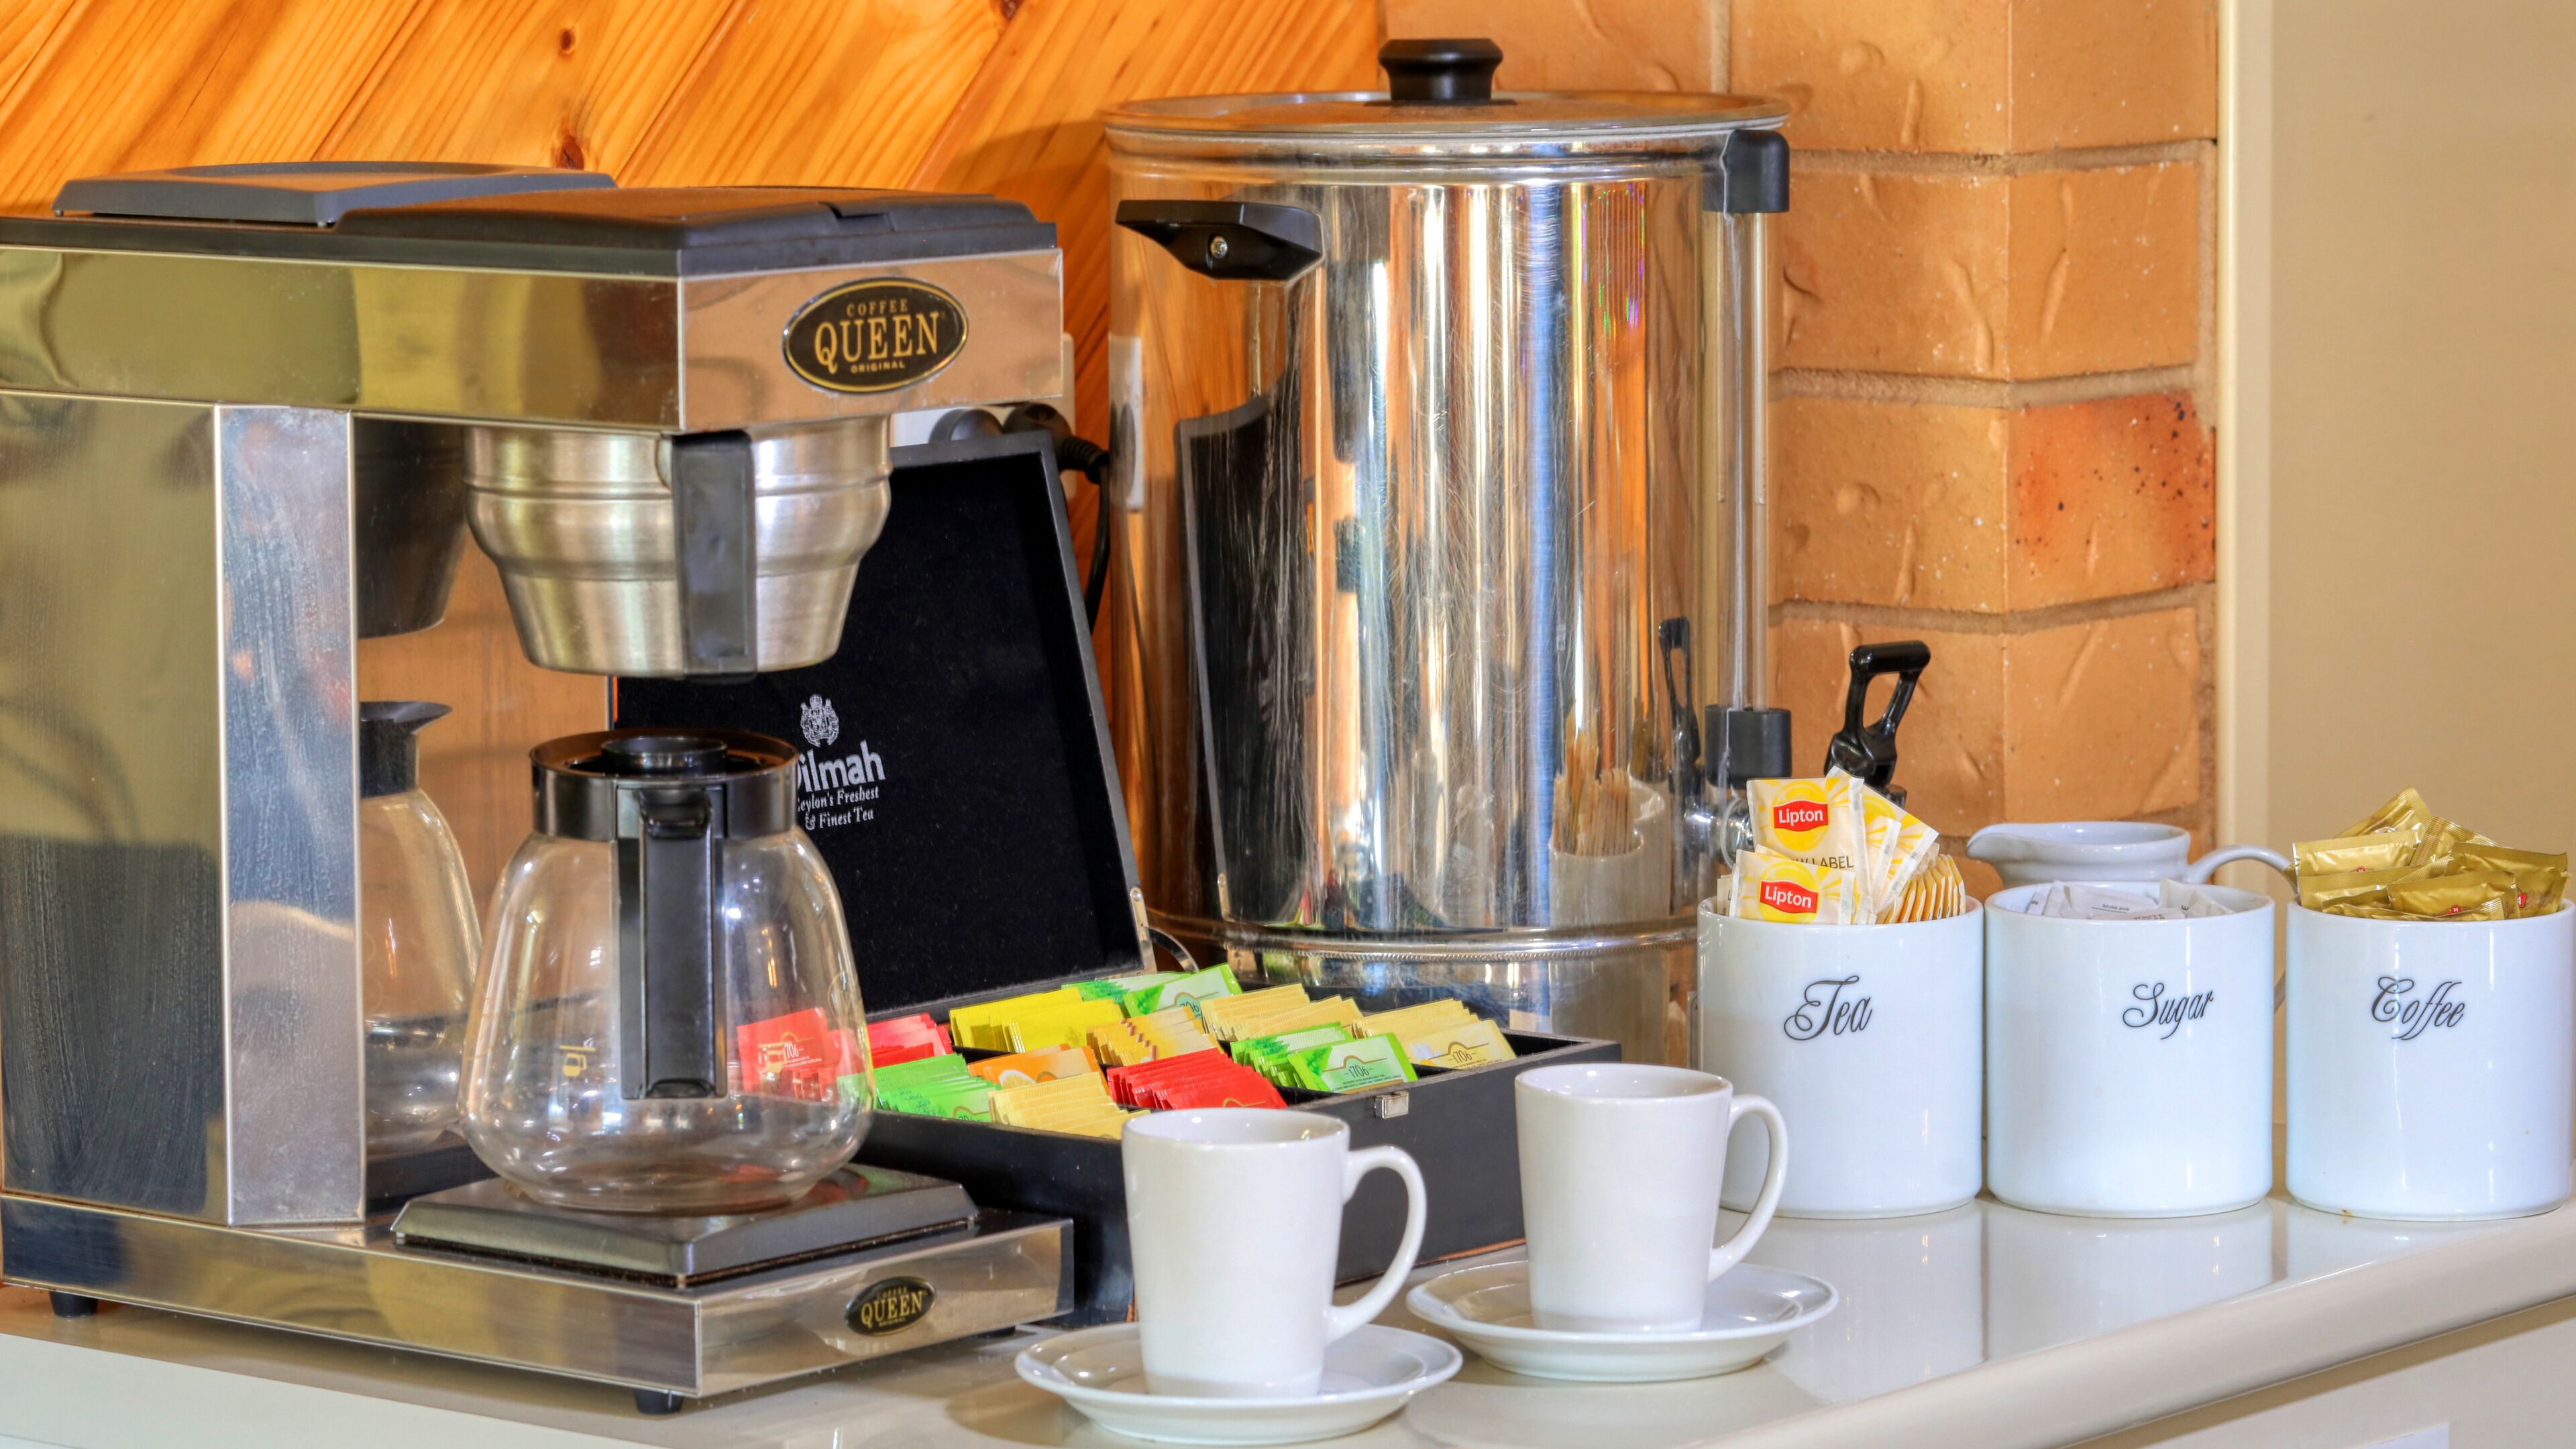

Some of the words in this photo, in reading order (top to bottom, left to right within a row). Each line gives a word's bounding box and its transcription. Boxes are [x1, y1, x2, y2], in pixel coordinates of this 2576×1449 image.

[847, 299, 908, 317] COFFEE
[814, 312, 939, 374] QUEEN
[851, 360, 906, 374] ORIGINAL
[837, 785, 879, 805] Freshest
[805, 811, 816, 830] &
[819, 810, 852, 828] Finest
[853, 805, 874, 822] Tea
[1778, 808, 1824, 826] Lipton
[1764, 885, 1812, 908] Lipton
[1784, 975, 1873, 1040] Tea
[2123, 983, 2214, 1040] Sugar
[2371, 977, 2465, 1040] Coffee
[861, 1290, 923, 1329] QUEEN
